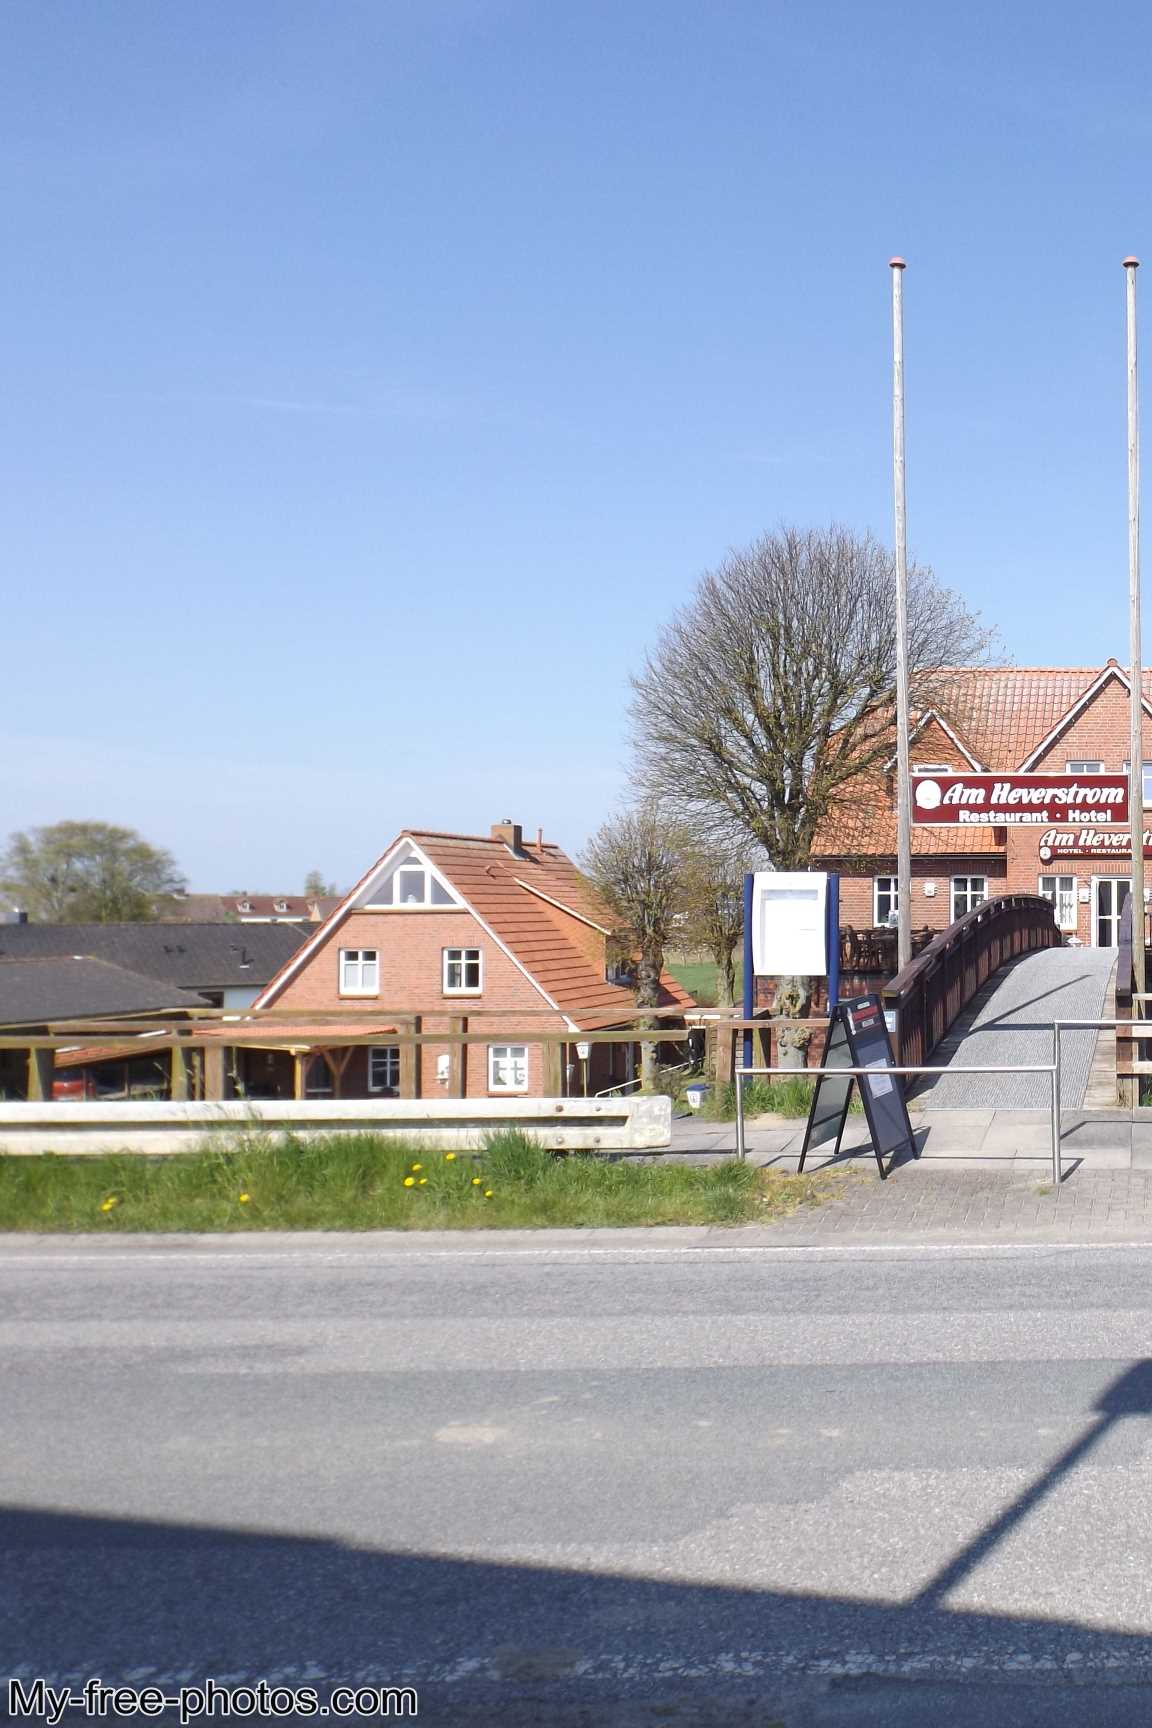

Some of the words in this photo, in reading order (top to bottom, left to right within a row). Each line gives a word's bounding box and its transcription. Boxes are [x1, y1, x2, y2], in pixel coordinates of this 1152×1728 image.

[943, 783, 985, 804] Am
[990, 783, 1124, 804] Heverstrom
[959, 810, 1048, 823] Restaurant
[1068, 810, 1111, 823] Hotel
[1040, 829, 1074, 847] Am
